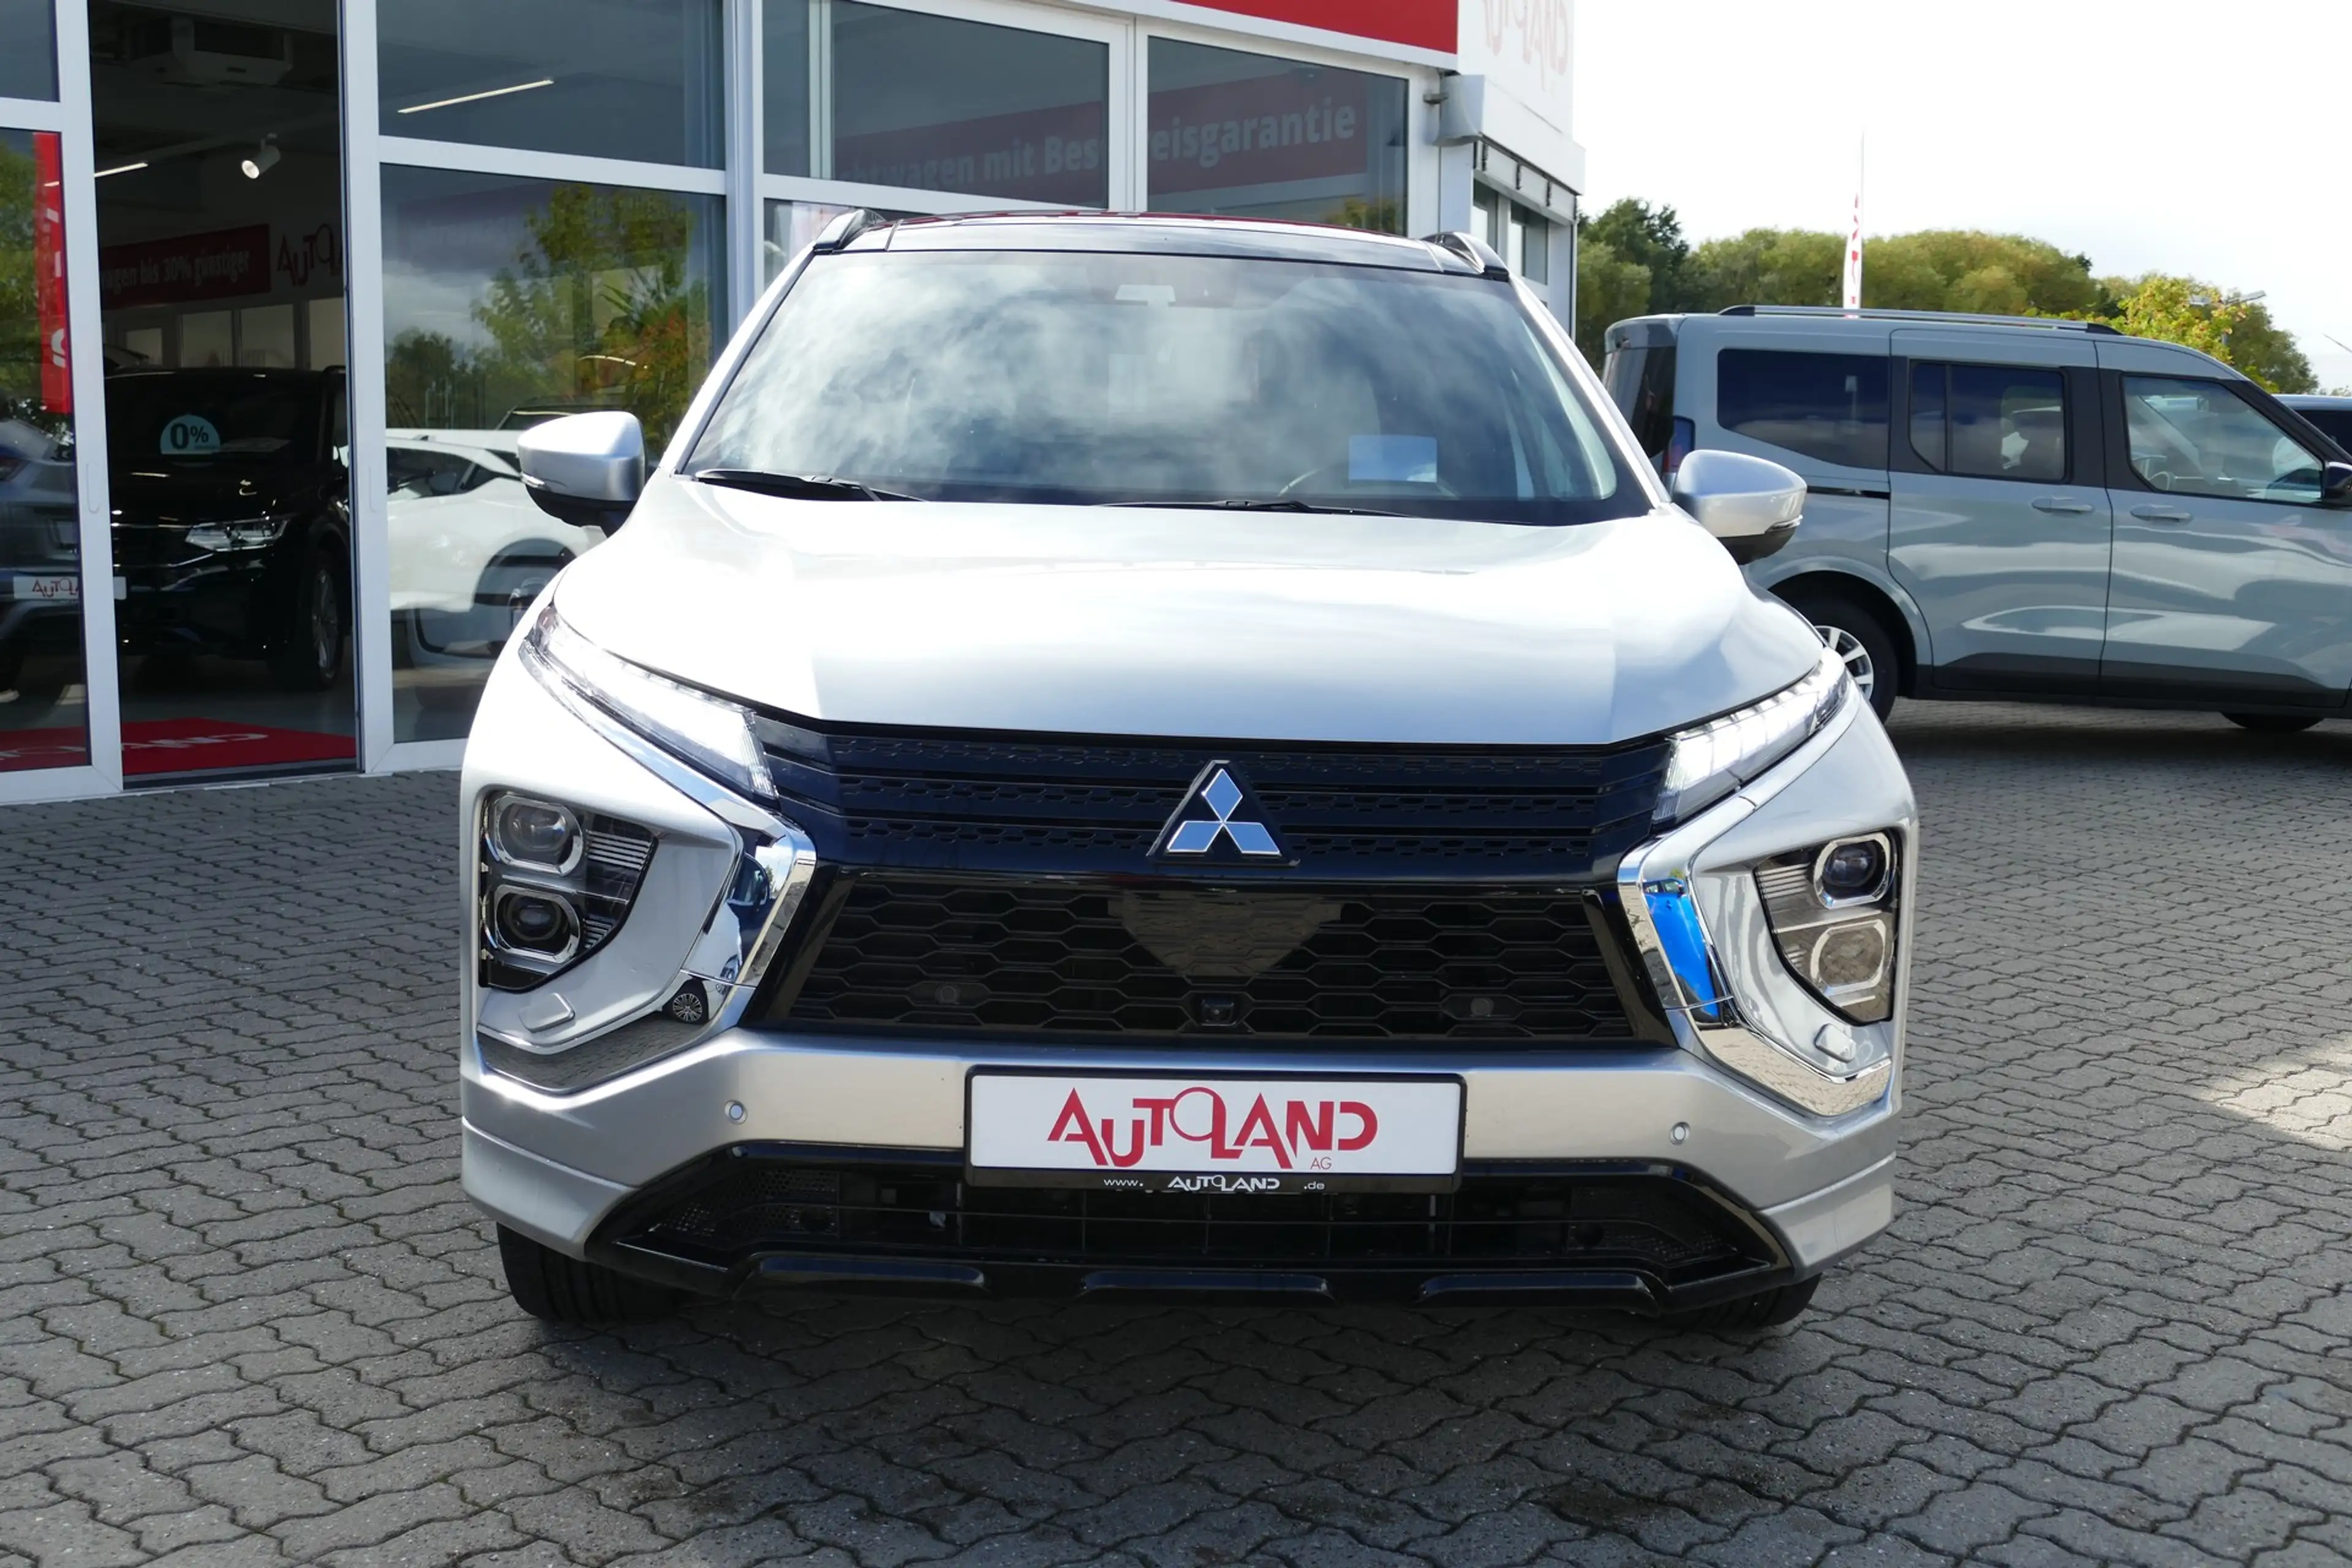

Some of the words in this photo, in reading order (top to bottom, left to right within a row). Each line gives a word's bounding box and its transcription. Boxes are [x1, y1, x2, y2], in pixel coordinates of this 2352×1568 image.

[984, 139, 1035, 181] mit
[1044, 135, 1102, 175] Bes
[1148, 96, 1356, 168] eisgarantie
[140, 258, 159, 284] bis
[194, 244, 250, 287] günstiger
[276, 224, 342, 286] AUTOL
[170, 423, 209, 450] 0%
[32, 577, 79, 598] AUTOL
[1047, 1086, 1378, 1169] AUTOLAND
[1310, 1156, 1332, 1170] AG
[1103, 1178, 1144, 1188] www.
[1167, 1174, 1280, 1193] AUTOLAND
[1303, 1181, 1325, 1191] .de
